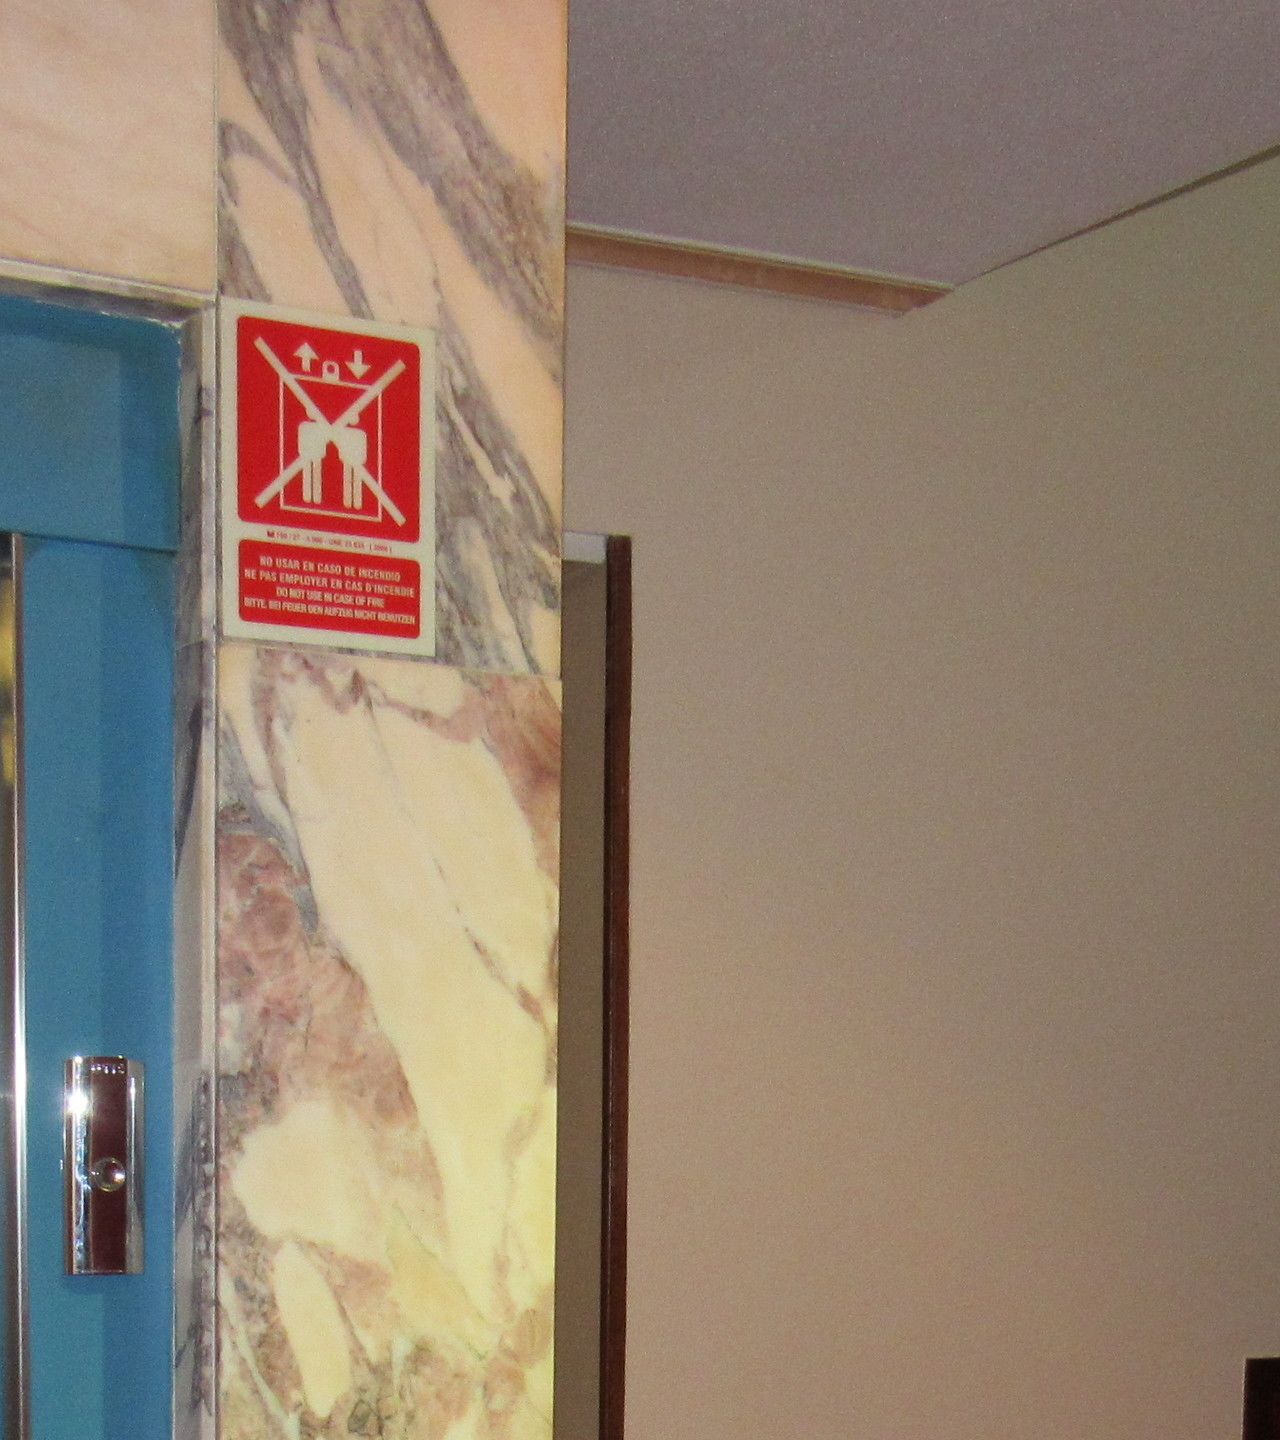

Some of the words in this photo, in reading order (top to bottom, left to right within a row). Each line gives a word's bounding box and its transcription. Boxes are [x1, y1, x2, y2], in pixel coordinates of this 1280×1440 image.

[244, 569, 256, 580] NE
[260, 570, 277, 582] PAS
[280, 572, 327, 588] EMPLOYER
[331, 578, 342, 589] EN
[345, 580, 363, 591] CAS
[259, 556, 272, 566] NO
[276, 557, 300, 569] USAR
[303, 561, 314, 571] EN
[318, 563, 341, 575] CASO
[344, 566, 357, 576] DE
[359, 569, 401, 582] INCENDIO
[276, 586, 288, 597] DO
[289, 588, 305, 599] NOT
[324, 592, 332, 602] IN
[333, 593, 354, 604] CASE
[356, 596, 366, 605] OF
[367, 597, 385, 608] FIRE
